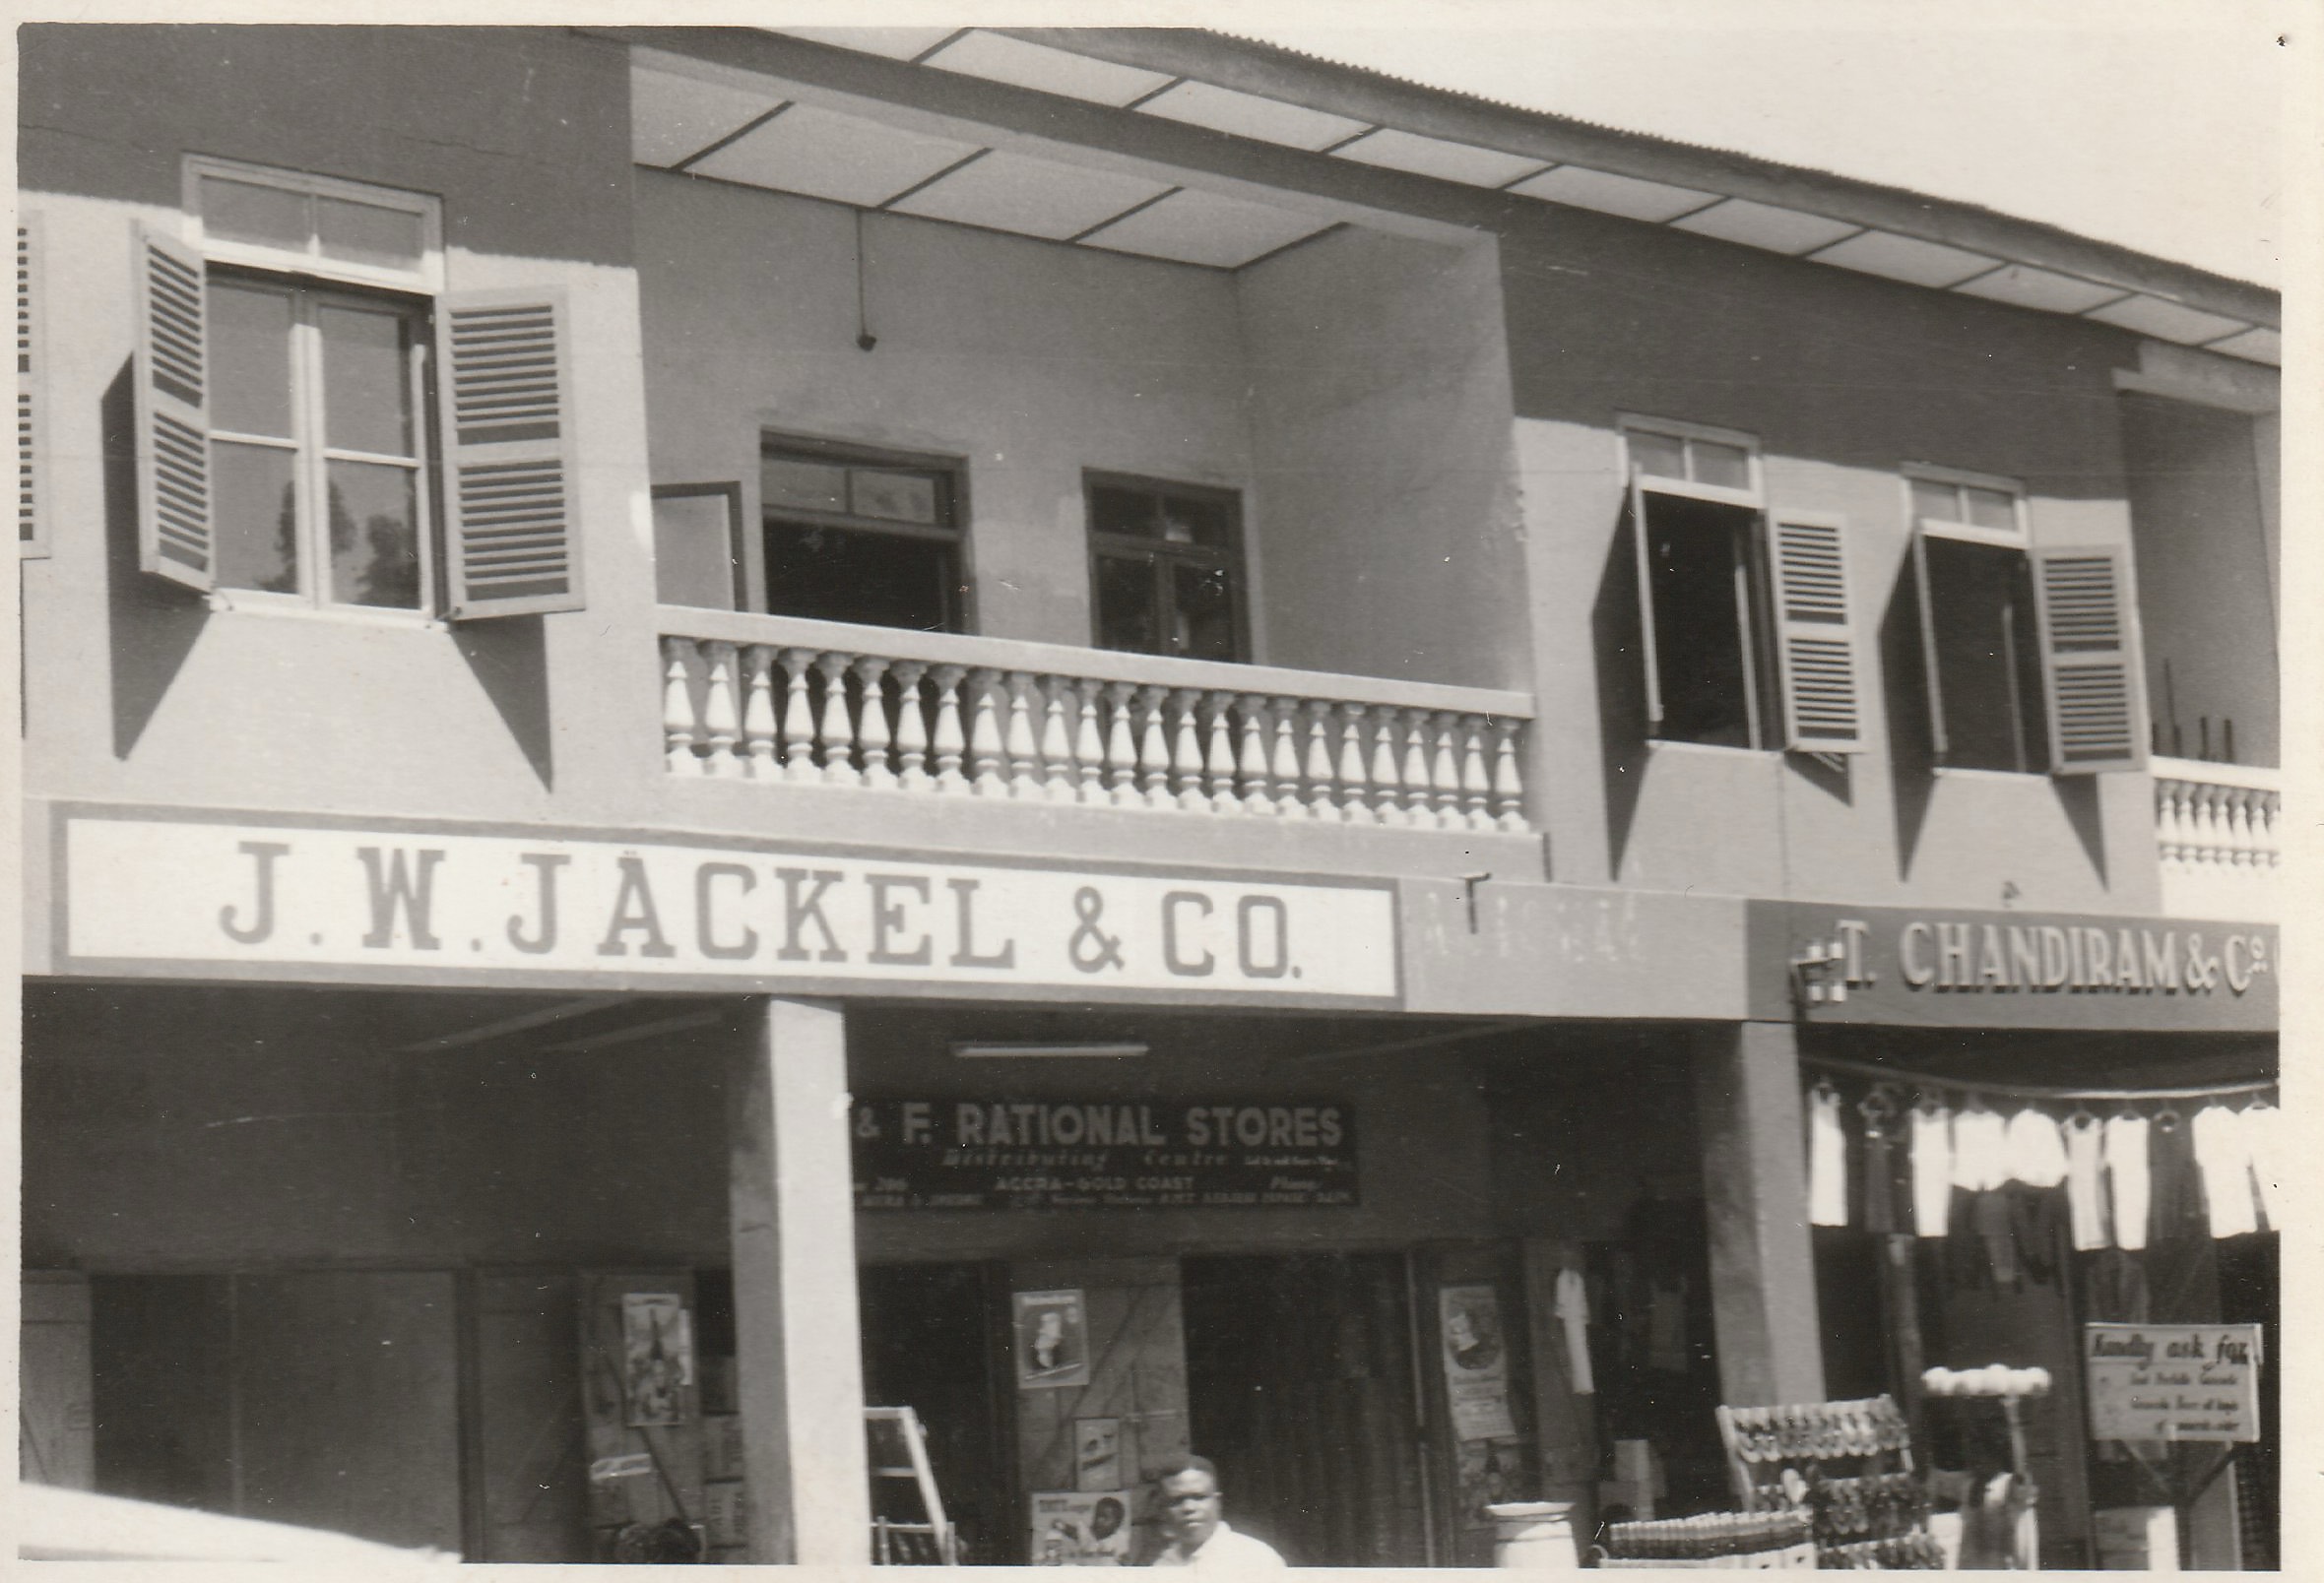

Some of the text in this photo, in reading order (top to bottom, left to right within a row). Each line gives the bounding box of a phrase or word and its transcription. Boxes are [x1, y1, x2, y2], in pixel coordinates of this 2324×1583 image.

[1067, 886, 1126, 973] &
[1161, 891, 1303, 979] CO.
[1900, 922, 2177, 990] CHANDIRAM
[2186, 931, 2220, 989] &
[856, 1102, 1343, 1147] & F. RATIONAL STORES
[1134, 1175, 1194, 1190] COAST
